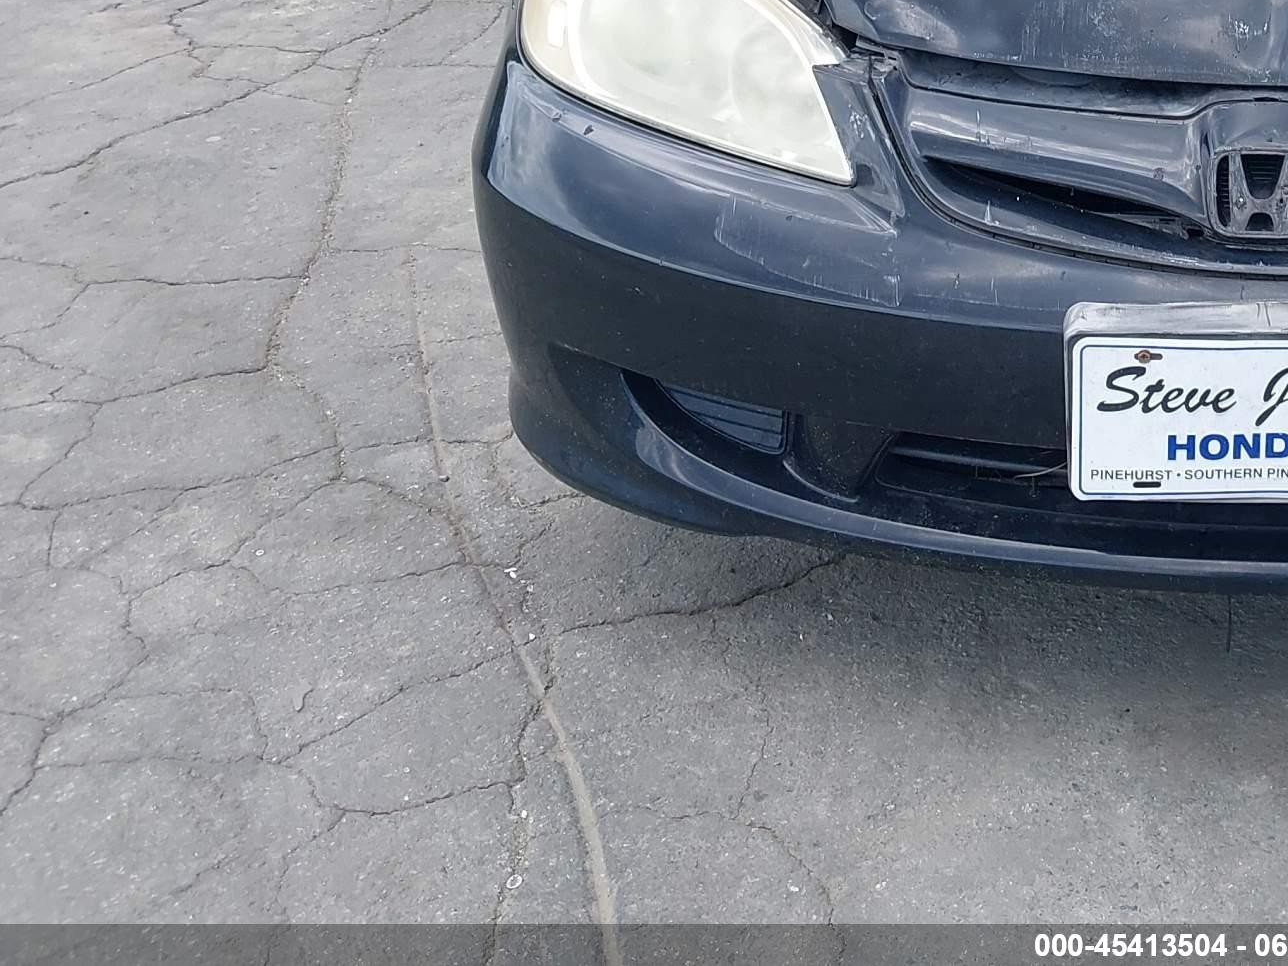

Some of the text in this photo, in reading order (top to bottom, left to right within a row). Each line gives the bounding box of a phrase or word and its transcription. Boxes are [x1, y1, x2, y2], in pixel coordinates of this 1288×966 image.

[1096, 365, 1237, 414] Steve
[1090, 469, 1173, 482] PINEHURST
[1184, 468, 1264, 480] SOUTHERN
